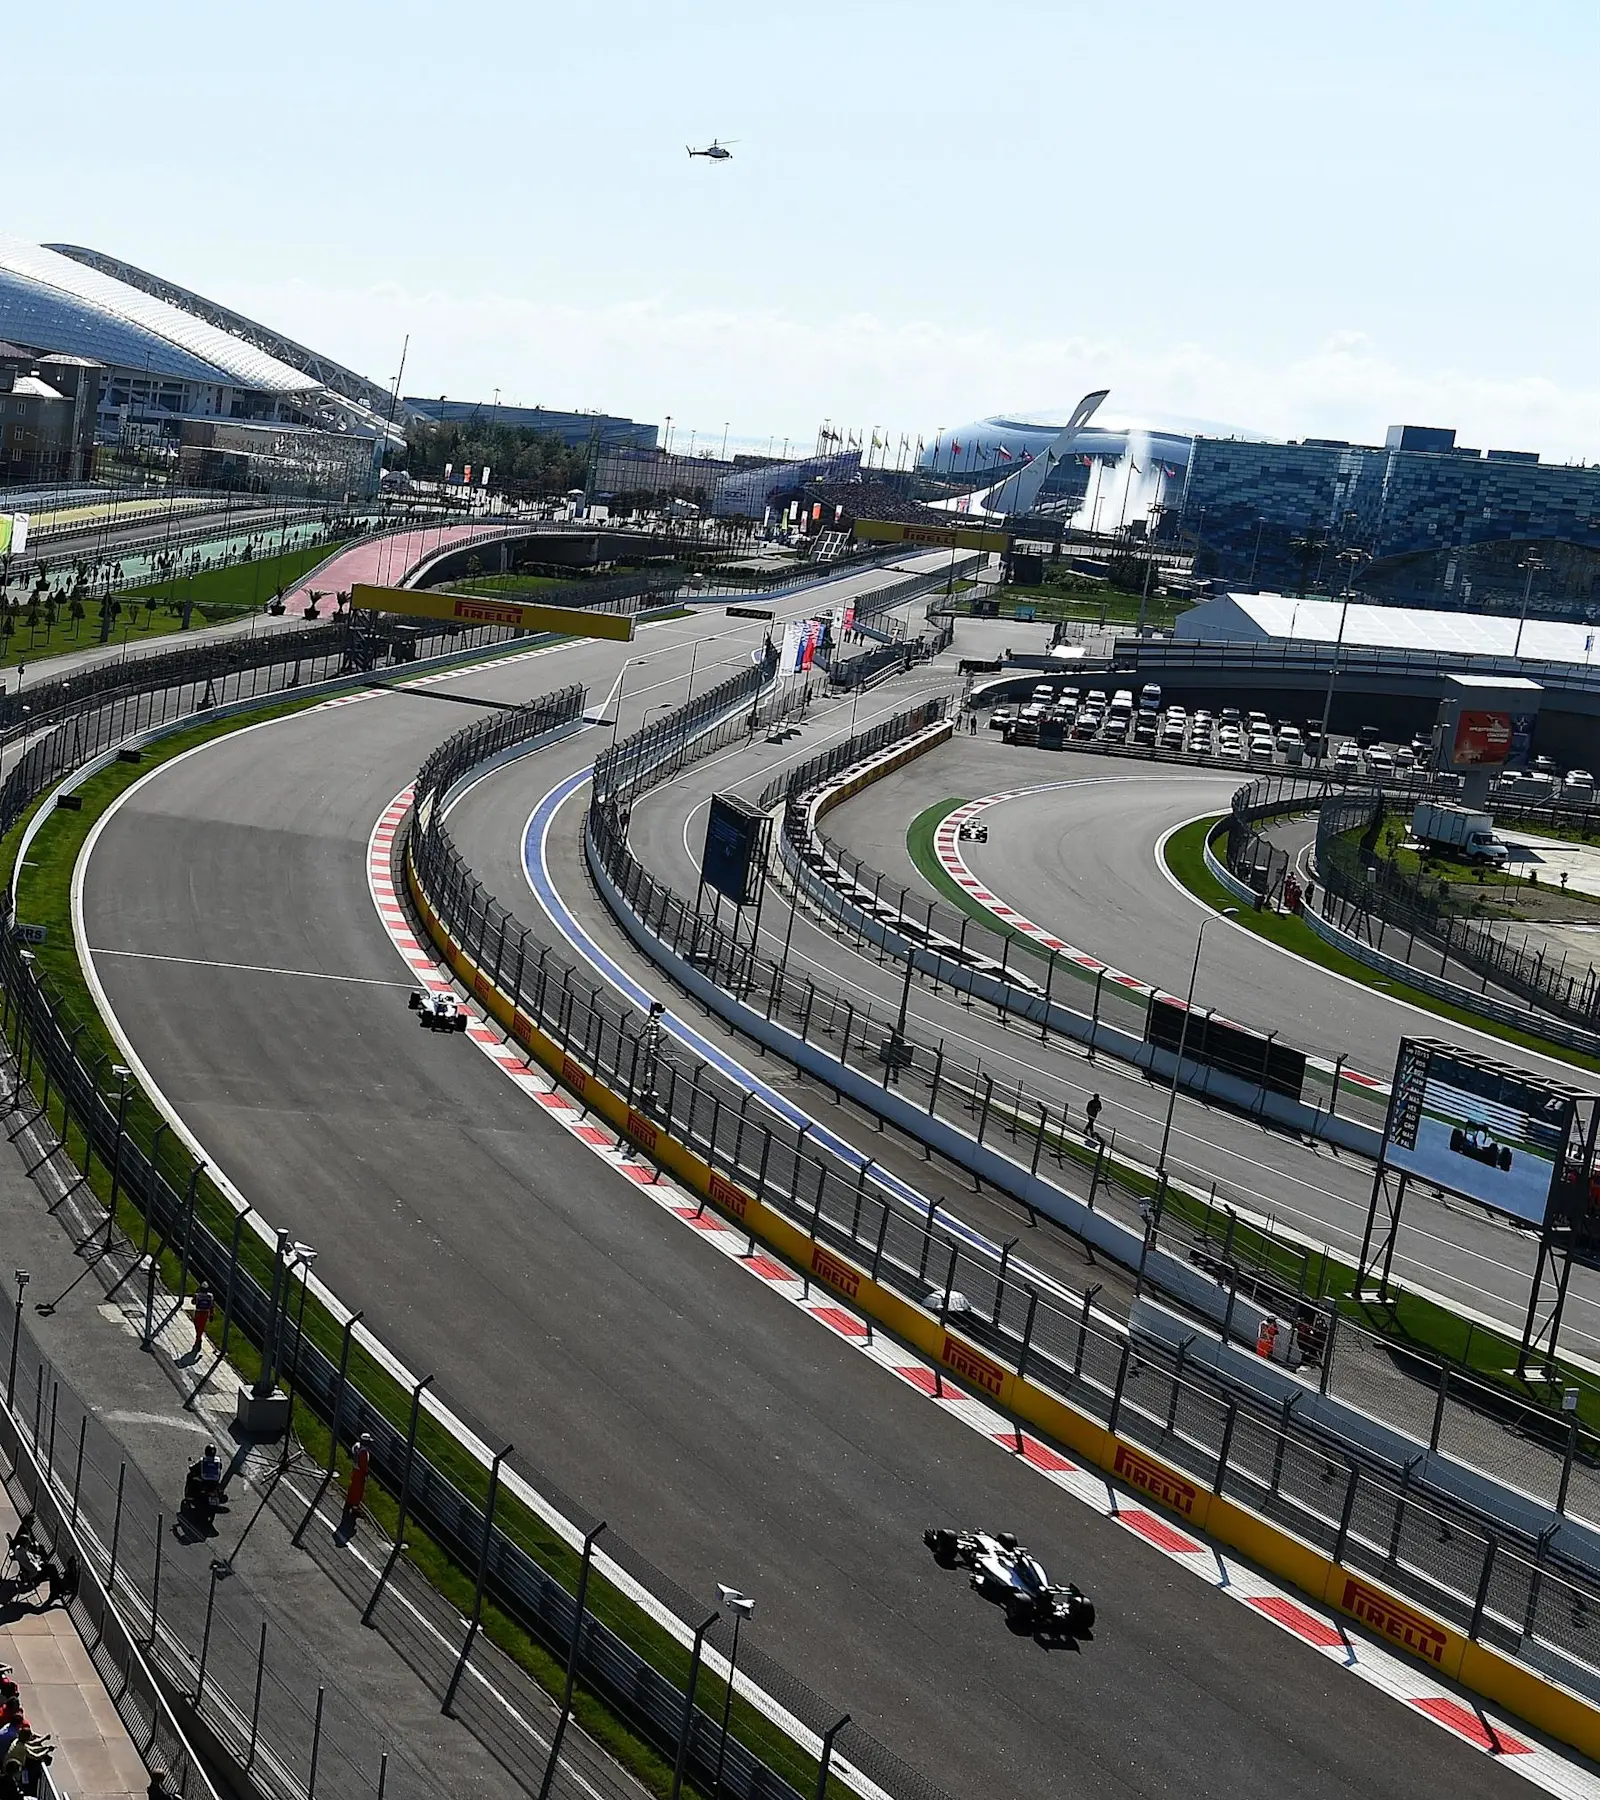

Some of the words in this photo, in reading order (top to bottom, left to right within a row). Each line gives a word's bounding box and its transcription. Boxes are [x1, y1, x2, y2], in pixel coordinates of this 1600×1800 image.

[454, 600, 523, 624] PIRELLI
[628, 1112, 657, 1151] PIRELLI
[710, 1172, 746, 1219] PIRELLI
[812, 1247, 860, 1299] PIRELLI
[942, 1336, 1004, 1396] PIRELLI
[1113, 1444, 1197, 1515] PIRELLI
[1341, 1578, 1447, 1663] PIRELLI
